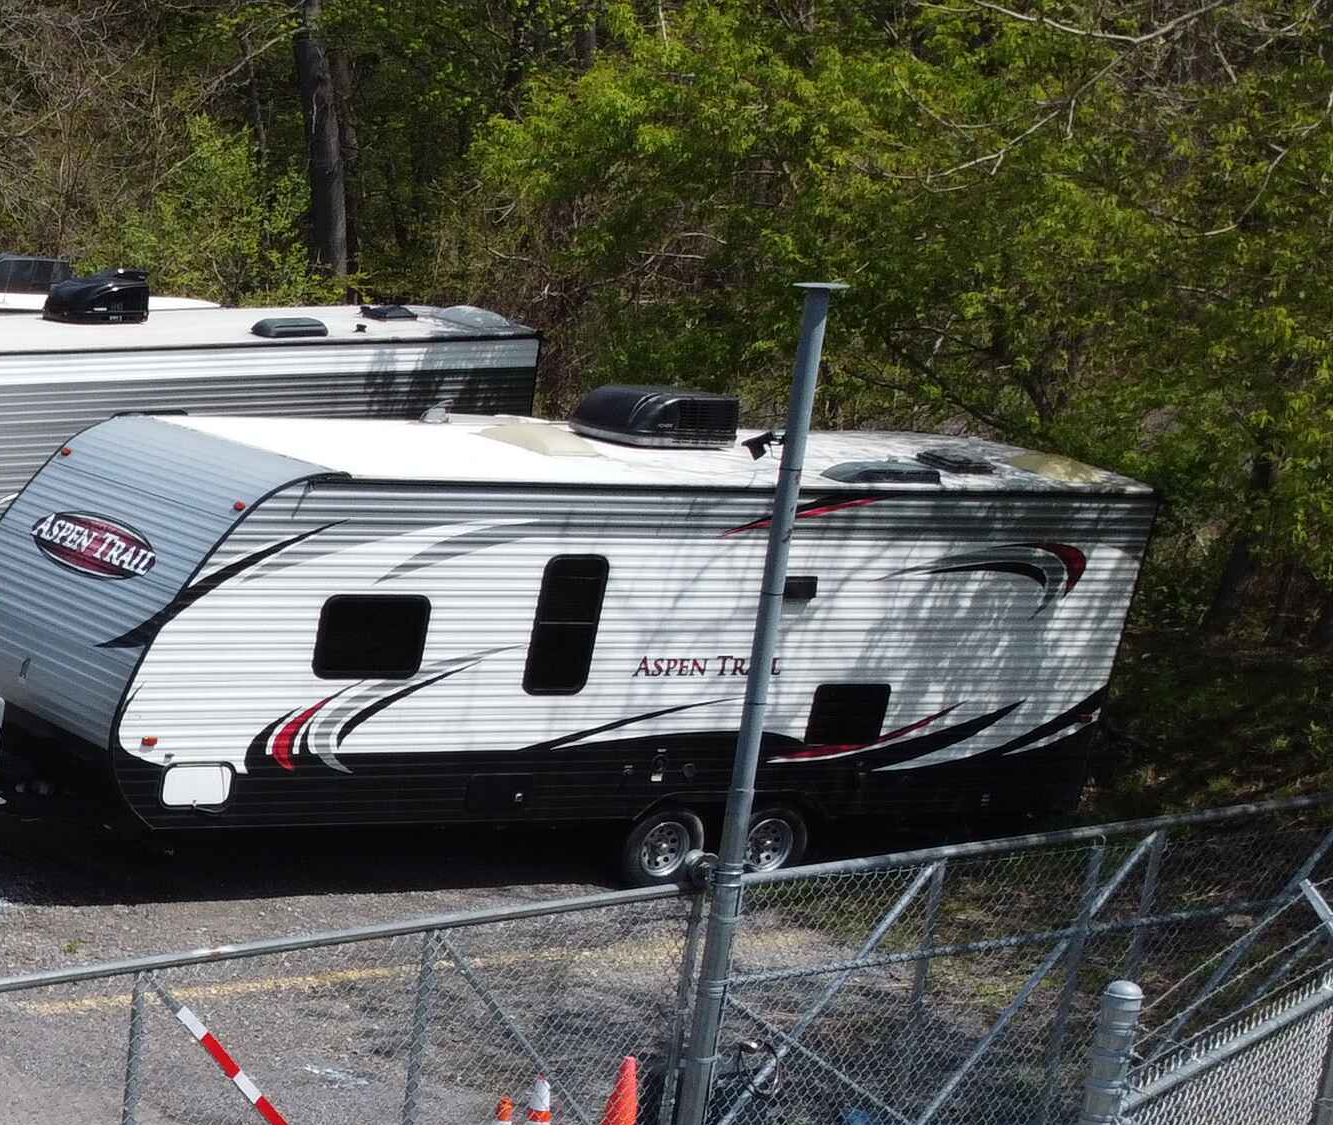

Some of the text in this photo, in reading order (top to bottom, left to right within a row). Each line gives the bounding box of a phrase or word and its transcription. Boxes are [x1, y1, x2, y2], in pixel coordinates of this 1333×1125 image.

[30, 513, 157, 576] ASPEN TRAIL
[632, 655, 781, 677] ASPEN TRL
